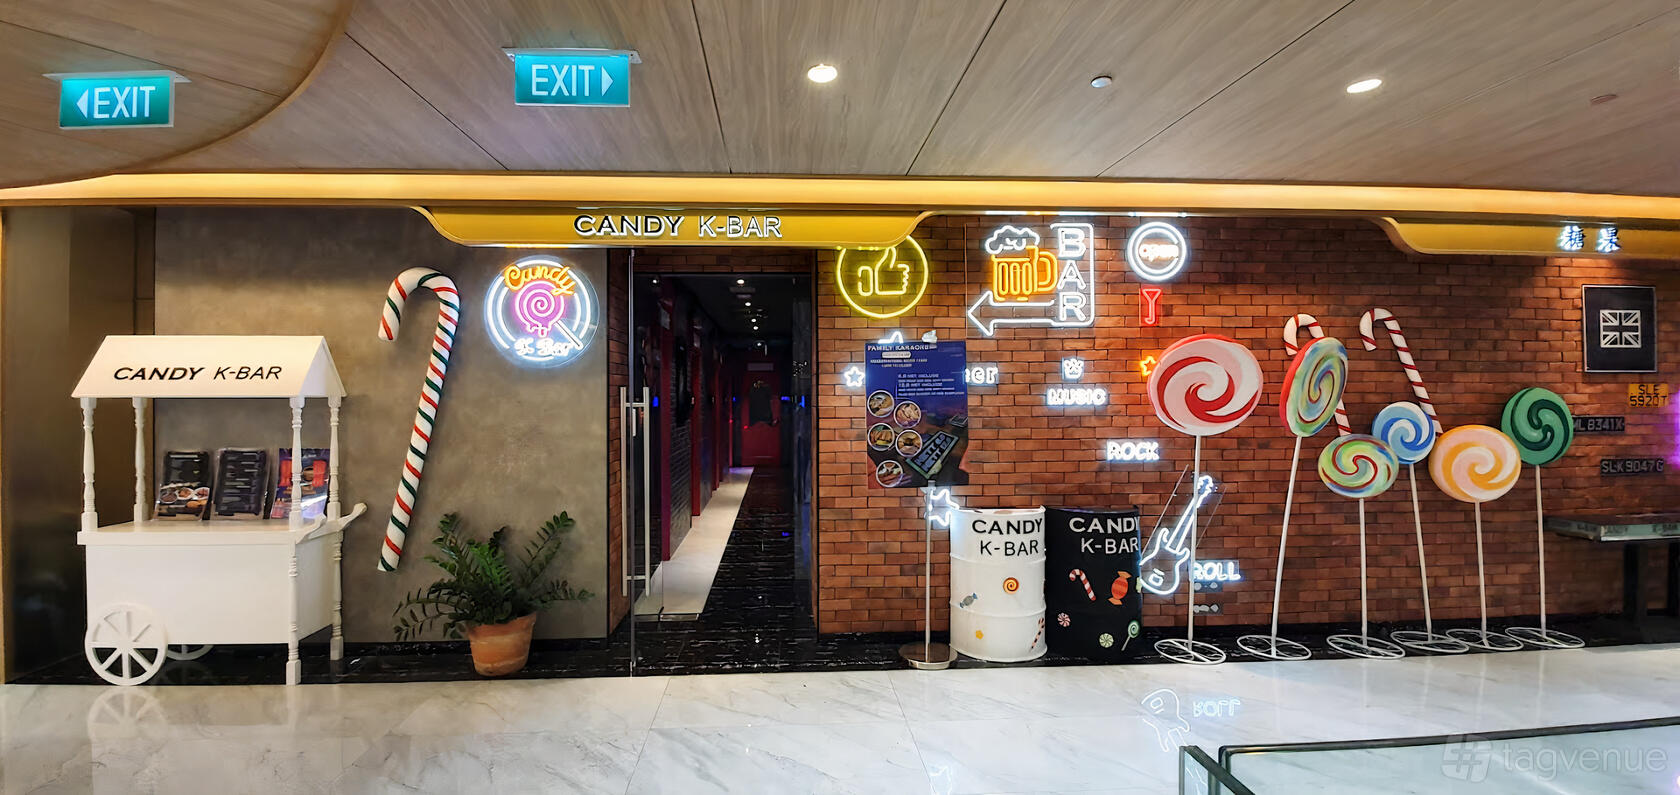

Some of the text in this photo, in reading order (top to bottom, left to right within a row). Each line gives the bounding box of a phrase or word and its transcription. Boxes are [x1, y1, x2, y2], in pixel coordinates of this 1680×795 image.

[531, 64, 595, 96] EXIT
[93, 86, 156, 119] EXIT
[573, 214, 783, 238] CANDY K-BAR
[503, 264, 576, 296] Candy
[1057, 227, 1087, 321] BAR
[113, 366, 282, 381] CANDY K-BAR
[1047, 388, 1107, 406] MUSIC
[1107, 442, 1159, 460] ROCK
[972, 518, 1043, 535] CANDY
[980, 540, 1039, 556] K-BAR
[1081, 537, 1139, 554] K-BAR
